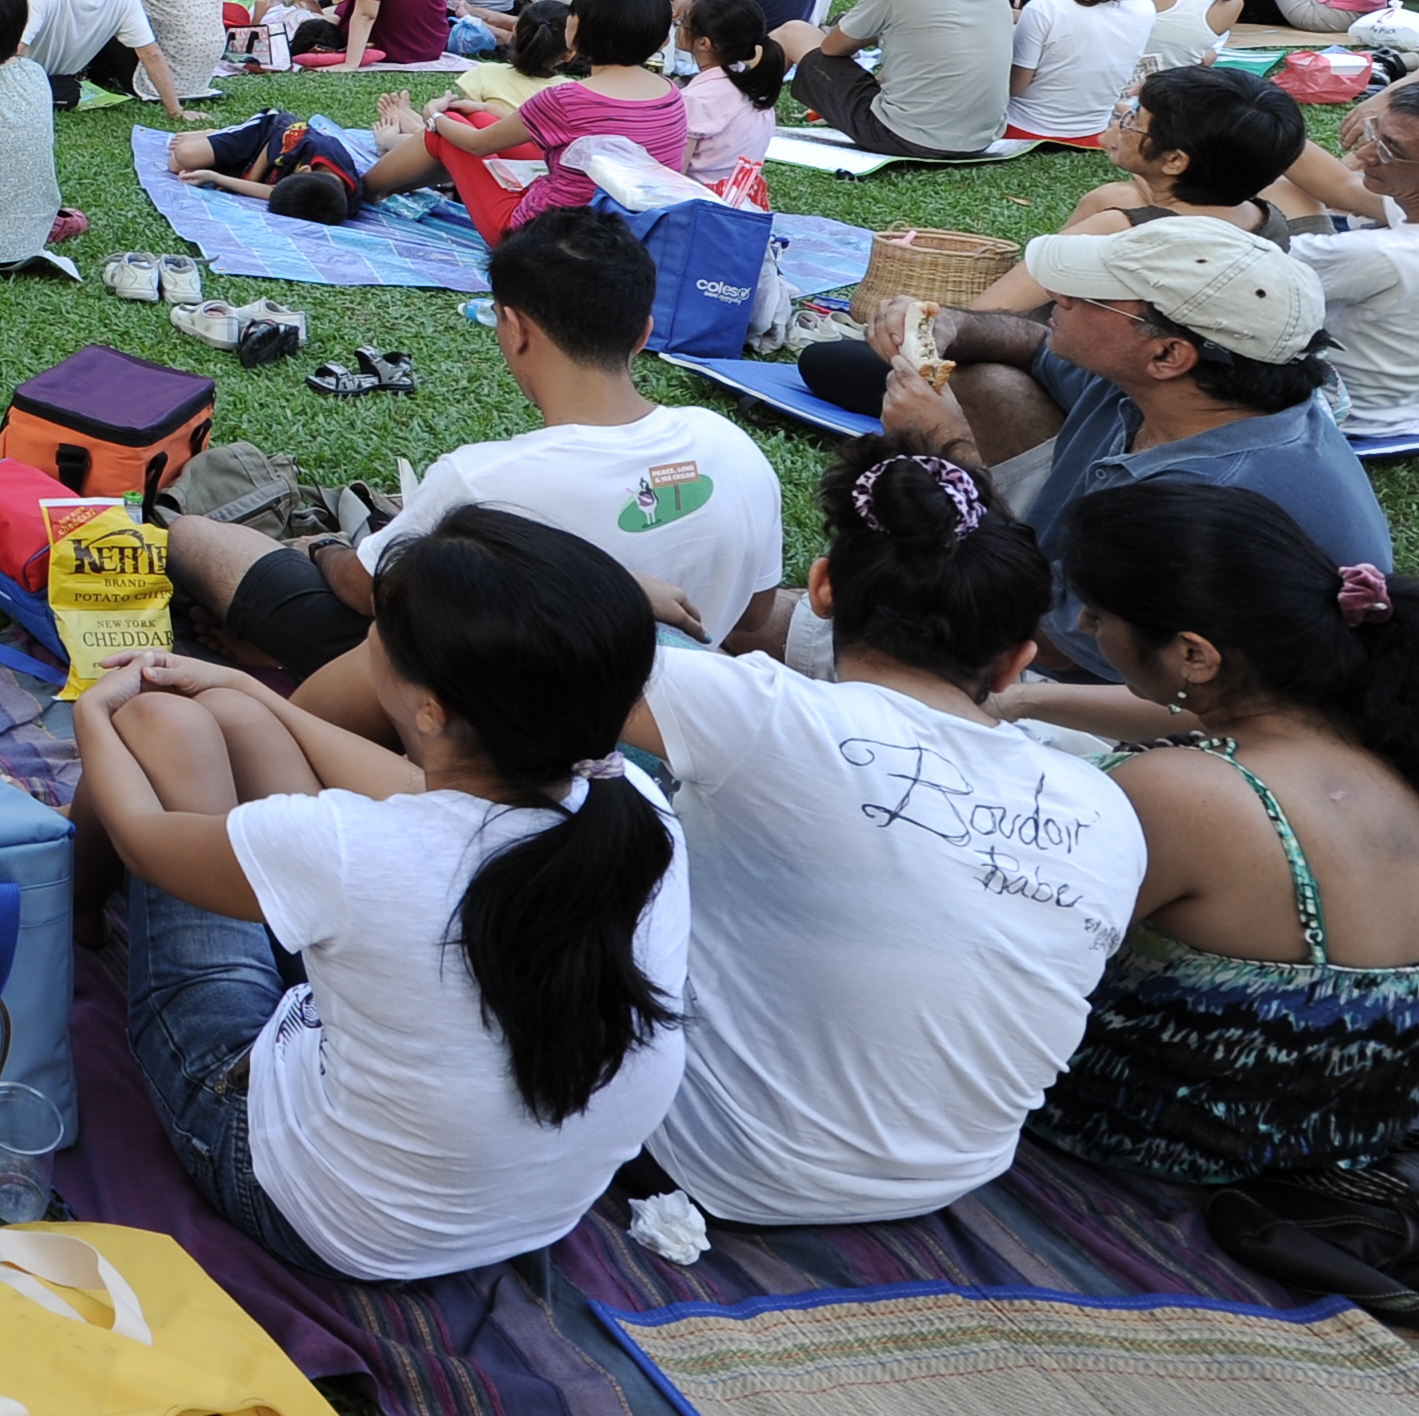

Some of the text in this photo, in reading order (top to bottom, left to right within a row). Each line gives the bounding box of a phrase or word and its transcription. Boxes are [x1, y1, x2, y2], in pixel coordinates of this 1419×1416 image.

[696, 279, 739, 297] coles
[677, 465, 695, 473] LOVE
[105, 578, 146, 588] BRAND
[74, 593, 131, 602] POTATO
[97, 619, 156, 628] NEW YORK
[82, 630, 174, 647] CHEDDAR
[973, 845, 1083, 907] Babe
